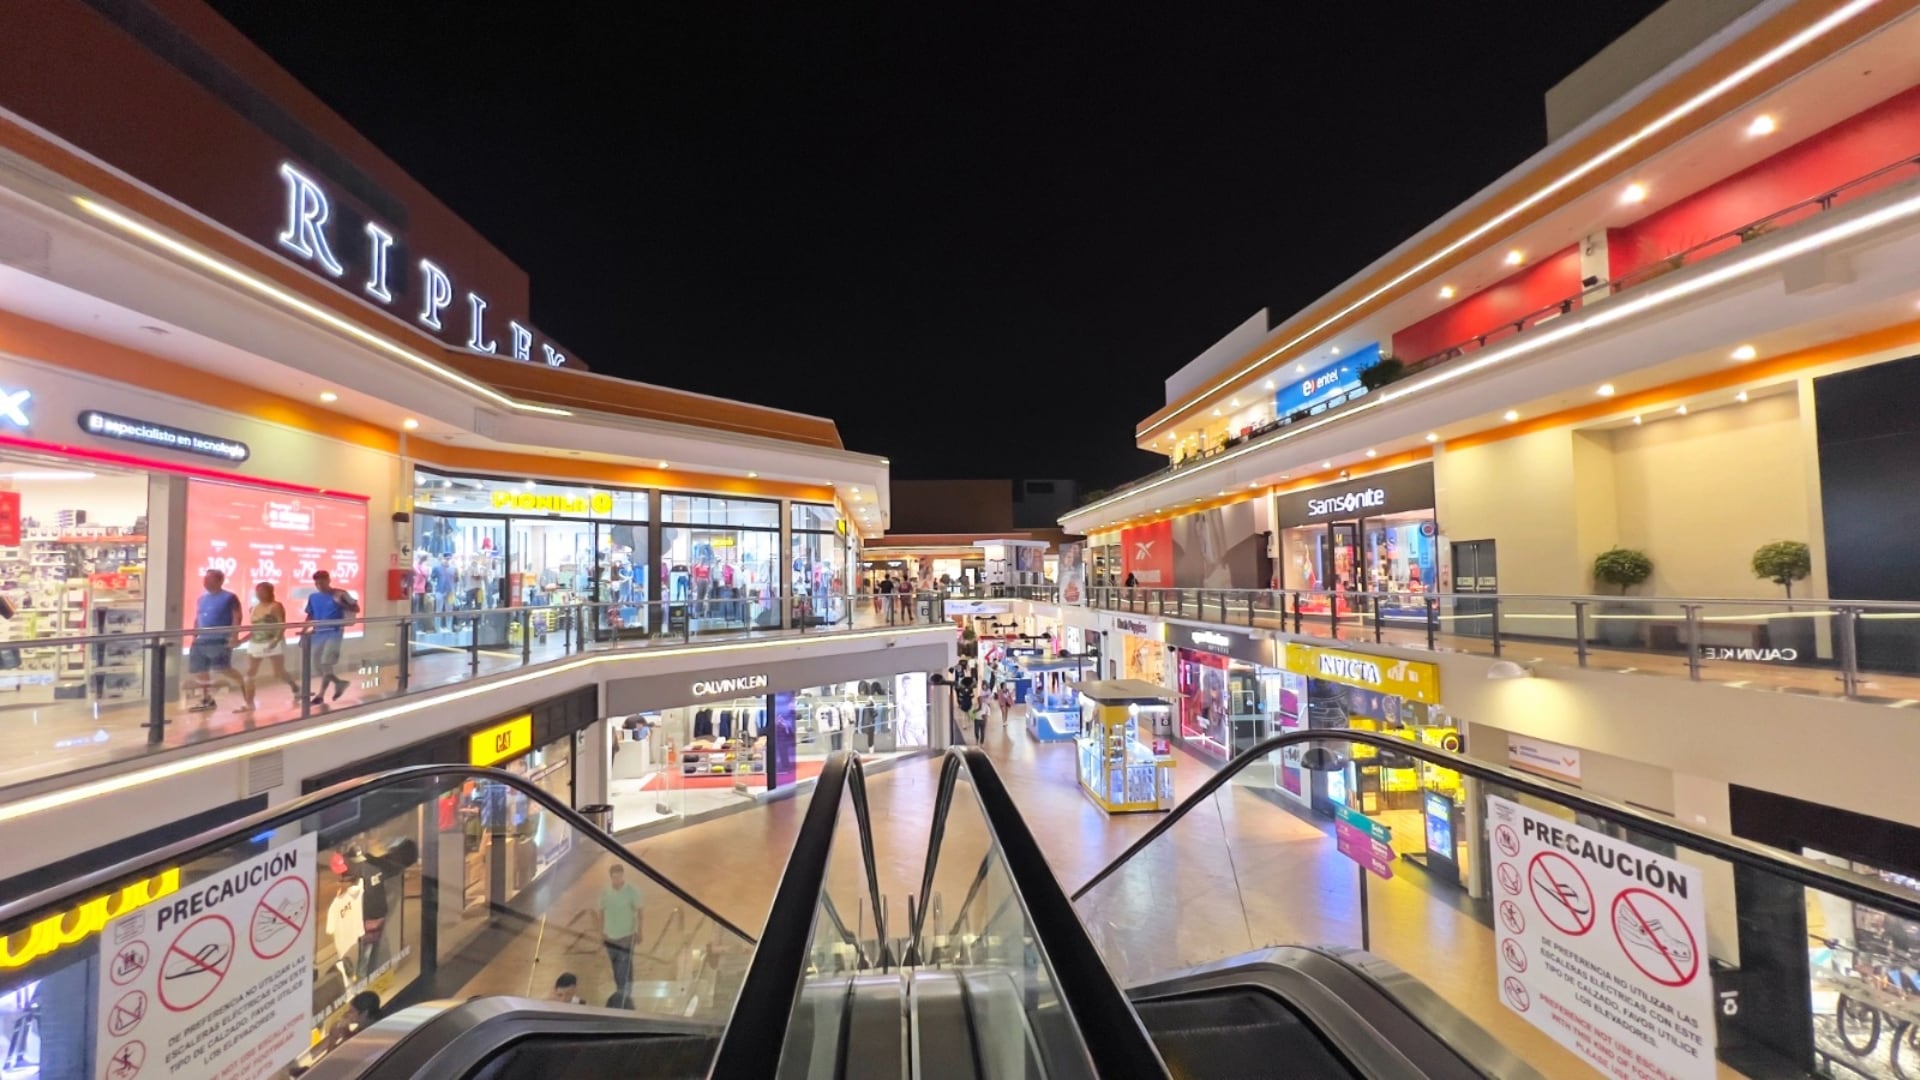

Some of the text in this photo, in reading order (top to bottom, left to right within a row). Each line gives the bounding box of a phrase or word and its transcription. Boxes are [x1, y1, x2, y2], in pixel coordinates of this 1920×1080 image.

[278, 161, 567, 368] RIPLEY
[1317, 368, 1338, 389] entel
[104, 419, 176, 443] especialista
[177, 434, 192, 446] en
[1307, 488, 1384, 516] Samsonite
[692, 674, 768, 697] CALVIN KLEIN
[1319, 654, 1381, 685] INVICTA
[496, 730, 512, 754] CAT
[1523, 816, 1688, 899] PRECAUCIÓN
[157, 849, 298, 932] PRECAUCIÓN
[168, 954, 306, 1048] DE PREFERENCIA NO UTILIZAR LAS
[1540, 936, 1699, 1029] DE PREFERENCIA NO UTILIZAR LAS
[1540, 946, 1589, 981] ESCALERAS
[1649, 1008, 1672, 1028] CON
[1675, 1023, 1704, 1046] ESTE
[1575, 991, 1592, 1008] LOS
[165, 1022, 221, 1064] ESCALERAS
[272, 978, 289, 993] CON
[289, 965, 307, 983] ESTE
[169, 1054, 192, 1075] TIPO
[193, 1045, 206, 1059] DE
[250, 997, 276, 1020] FAVOR
[276, 979, 304, 1003] UTILICE
[1539, 992, 1593, 1032] PREFERENCE
[1594, 1028, 1612, 1045] NOT
[1614, 1041, 1633, 1058] USE
[1545, 961, 1563, 978] TIPO
[1564, 974, 1576, 986] DE
[1623, 1007, 1655, 1032] FAVOR
[1658, 1028, 1699, 1059] UTILICE
[203, 1048, 222, 1065] LOS
[1576, 1040, 1608, 1069] PLEASE
[1593, 1040, 1615, 1059] KIND
[1617, 1055, 1629, 1068] OF
